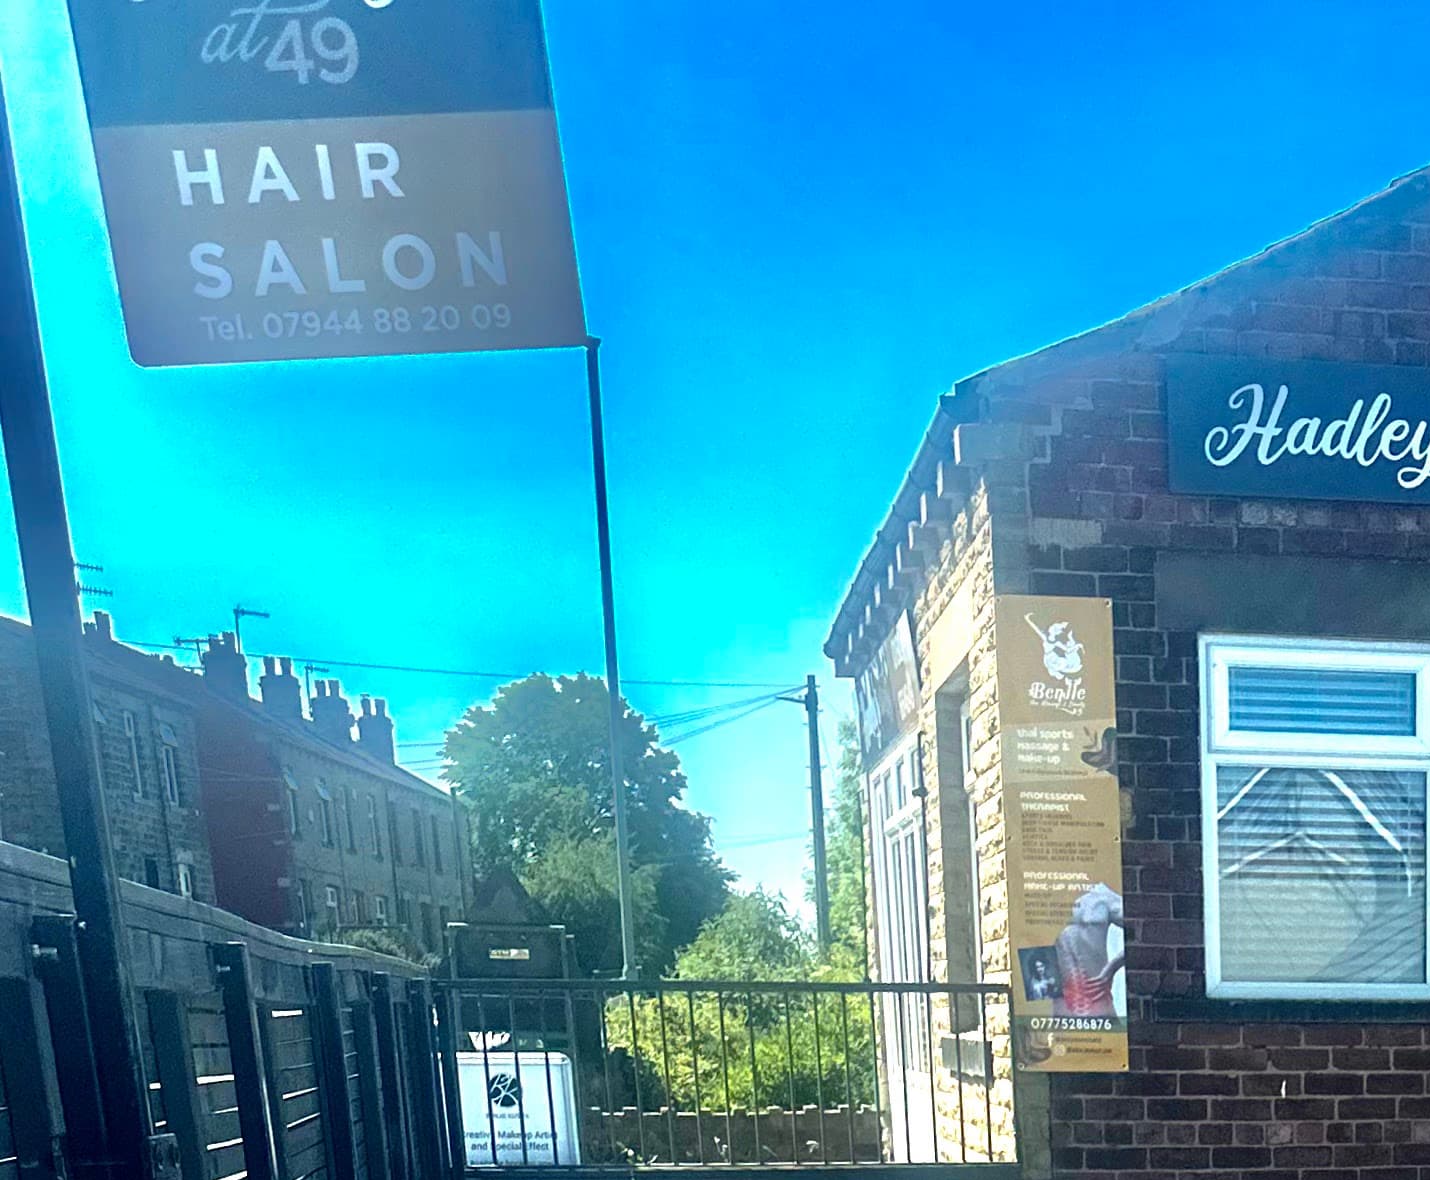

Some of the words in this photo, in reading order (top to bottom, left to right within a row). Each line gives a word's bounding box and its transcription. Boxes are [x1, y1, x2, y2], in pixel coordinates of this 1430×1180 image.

[264, 16, 359, 85] 49
[173, 142, 405, 206] HAIR
[189, 231, 508, 298] SALON
[201, 314, 252, 342] Tel.
[262, 310, 363, 338] 07944
[373, 308, 411, 334] 88
[421, 305, 461, 332] 20
[471, 303, 511, 330] 09
[1031, 1017, 1112, 1030] 07775286876
